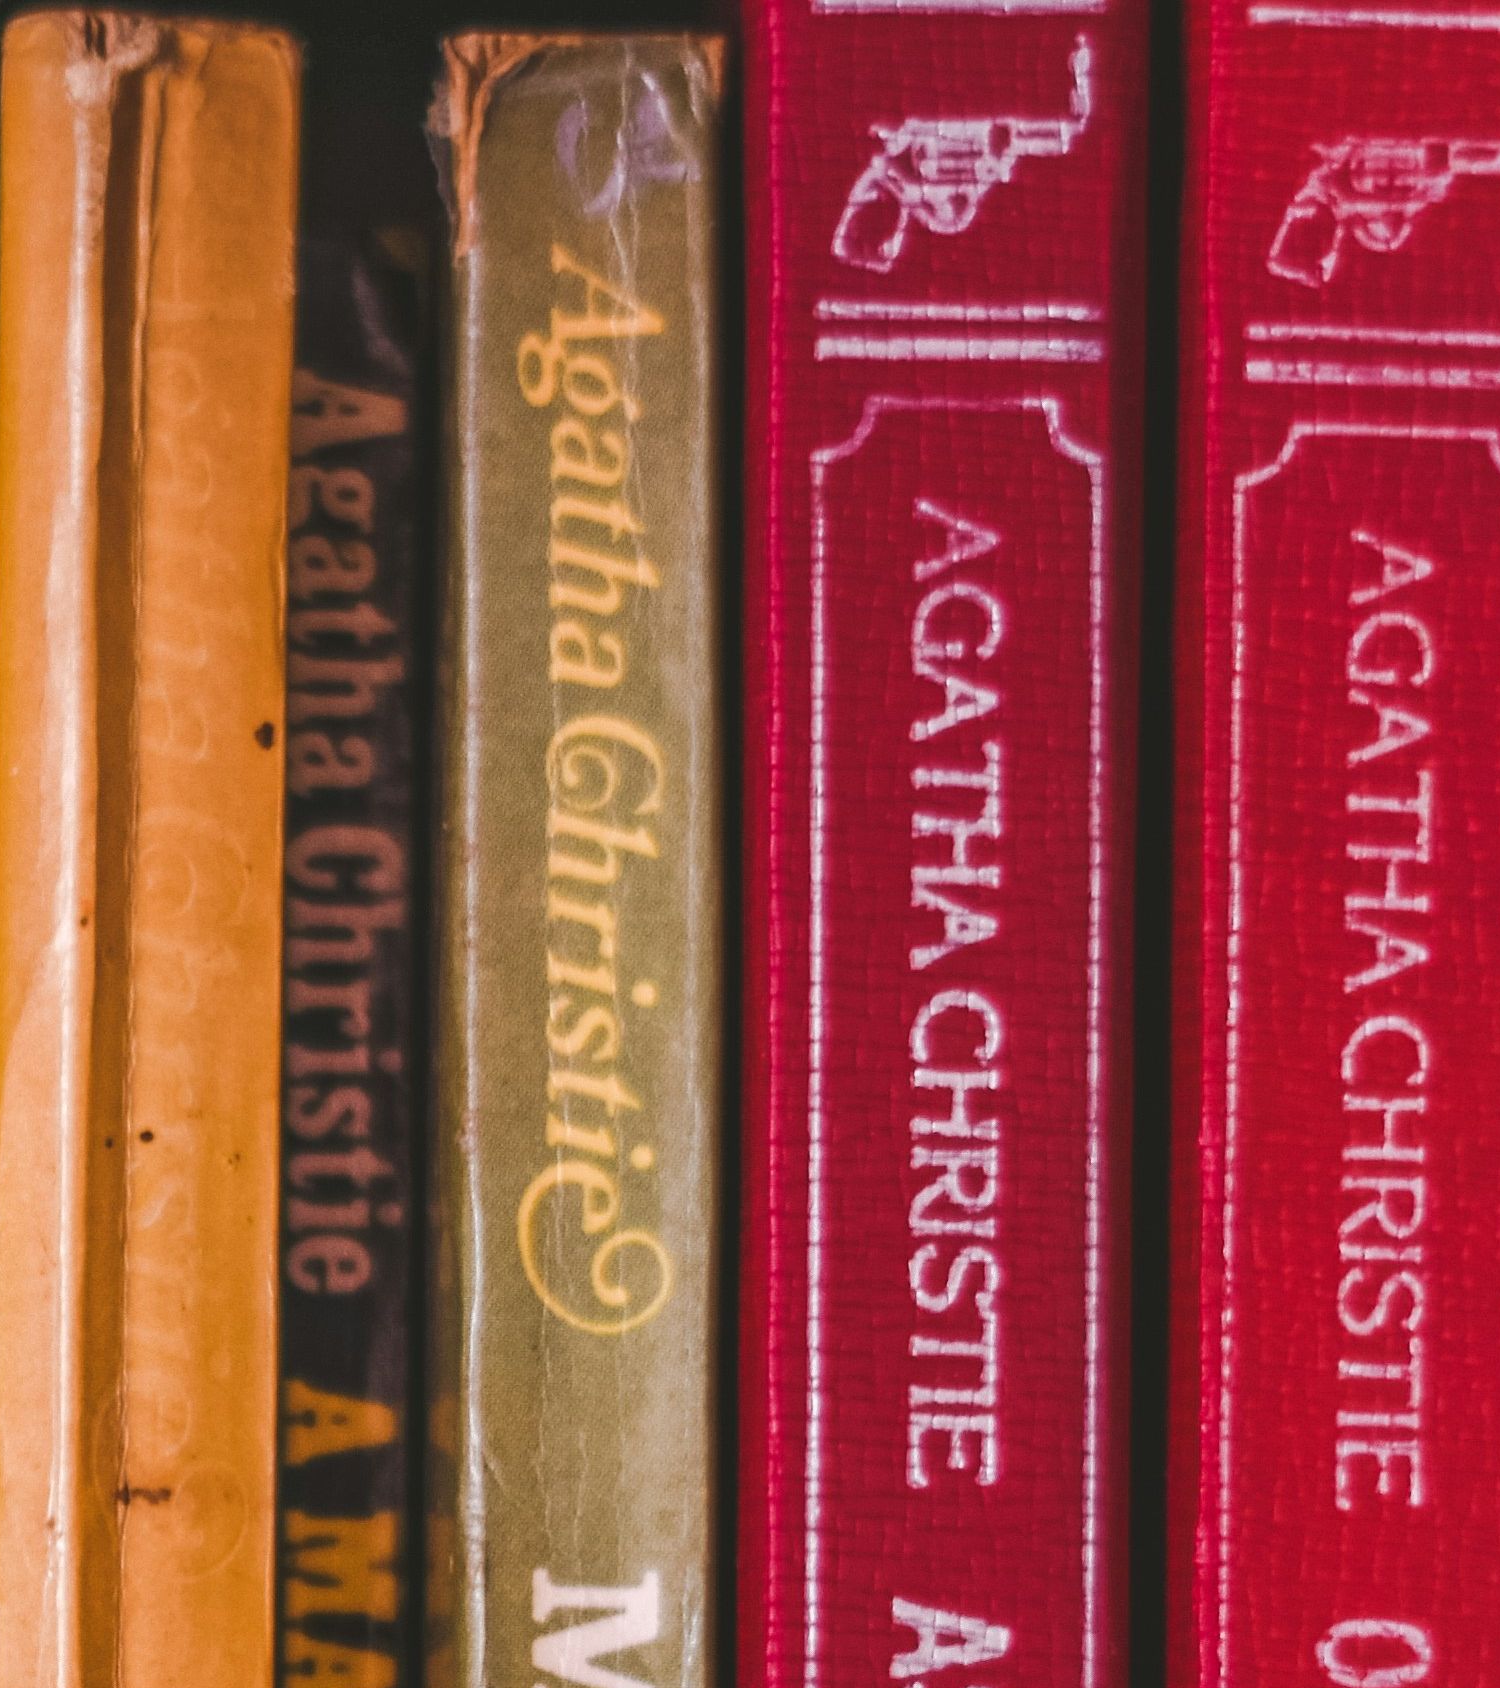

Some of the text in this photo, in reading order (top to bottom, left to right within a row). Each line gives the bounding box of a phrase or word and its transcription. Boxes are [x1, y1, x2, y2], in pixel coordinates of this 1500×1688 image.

[285, 365, 410, 795] Agatha
[517, 239, 670, 687] Agatha
[910, 501, 1003, 970] AGATHA
[1343, 527, 1434, 993] AGATHA
[288, 823, 410, 1296] Christie
[517, 717, 672, 1335] Christie
[906, 988, 1004, 1490] CHRISTIE
[284, 1379, 406, 1485] A
[1335, 1015, 1432, 1511] CHRISTIE
